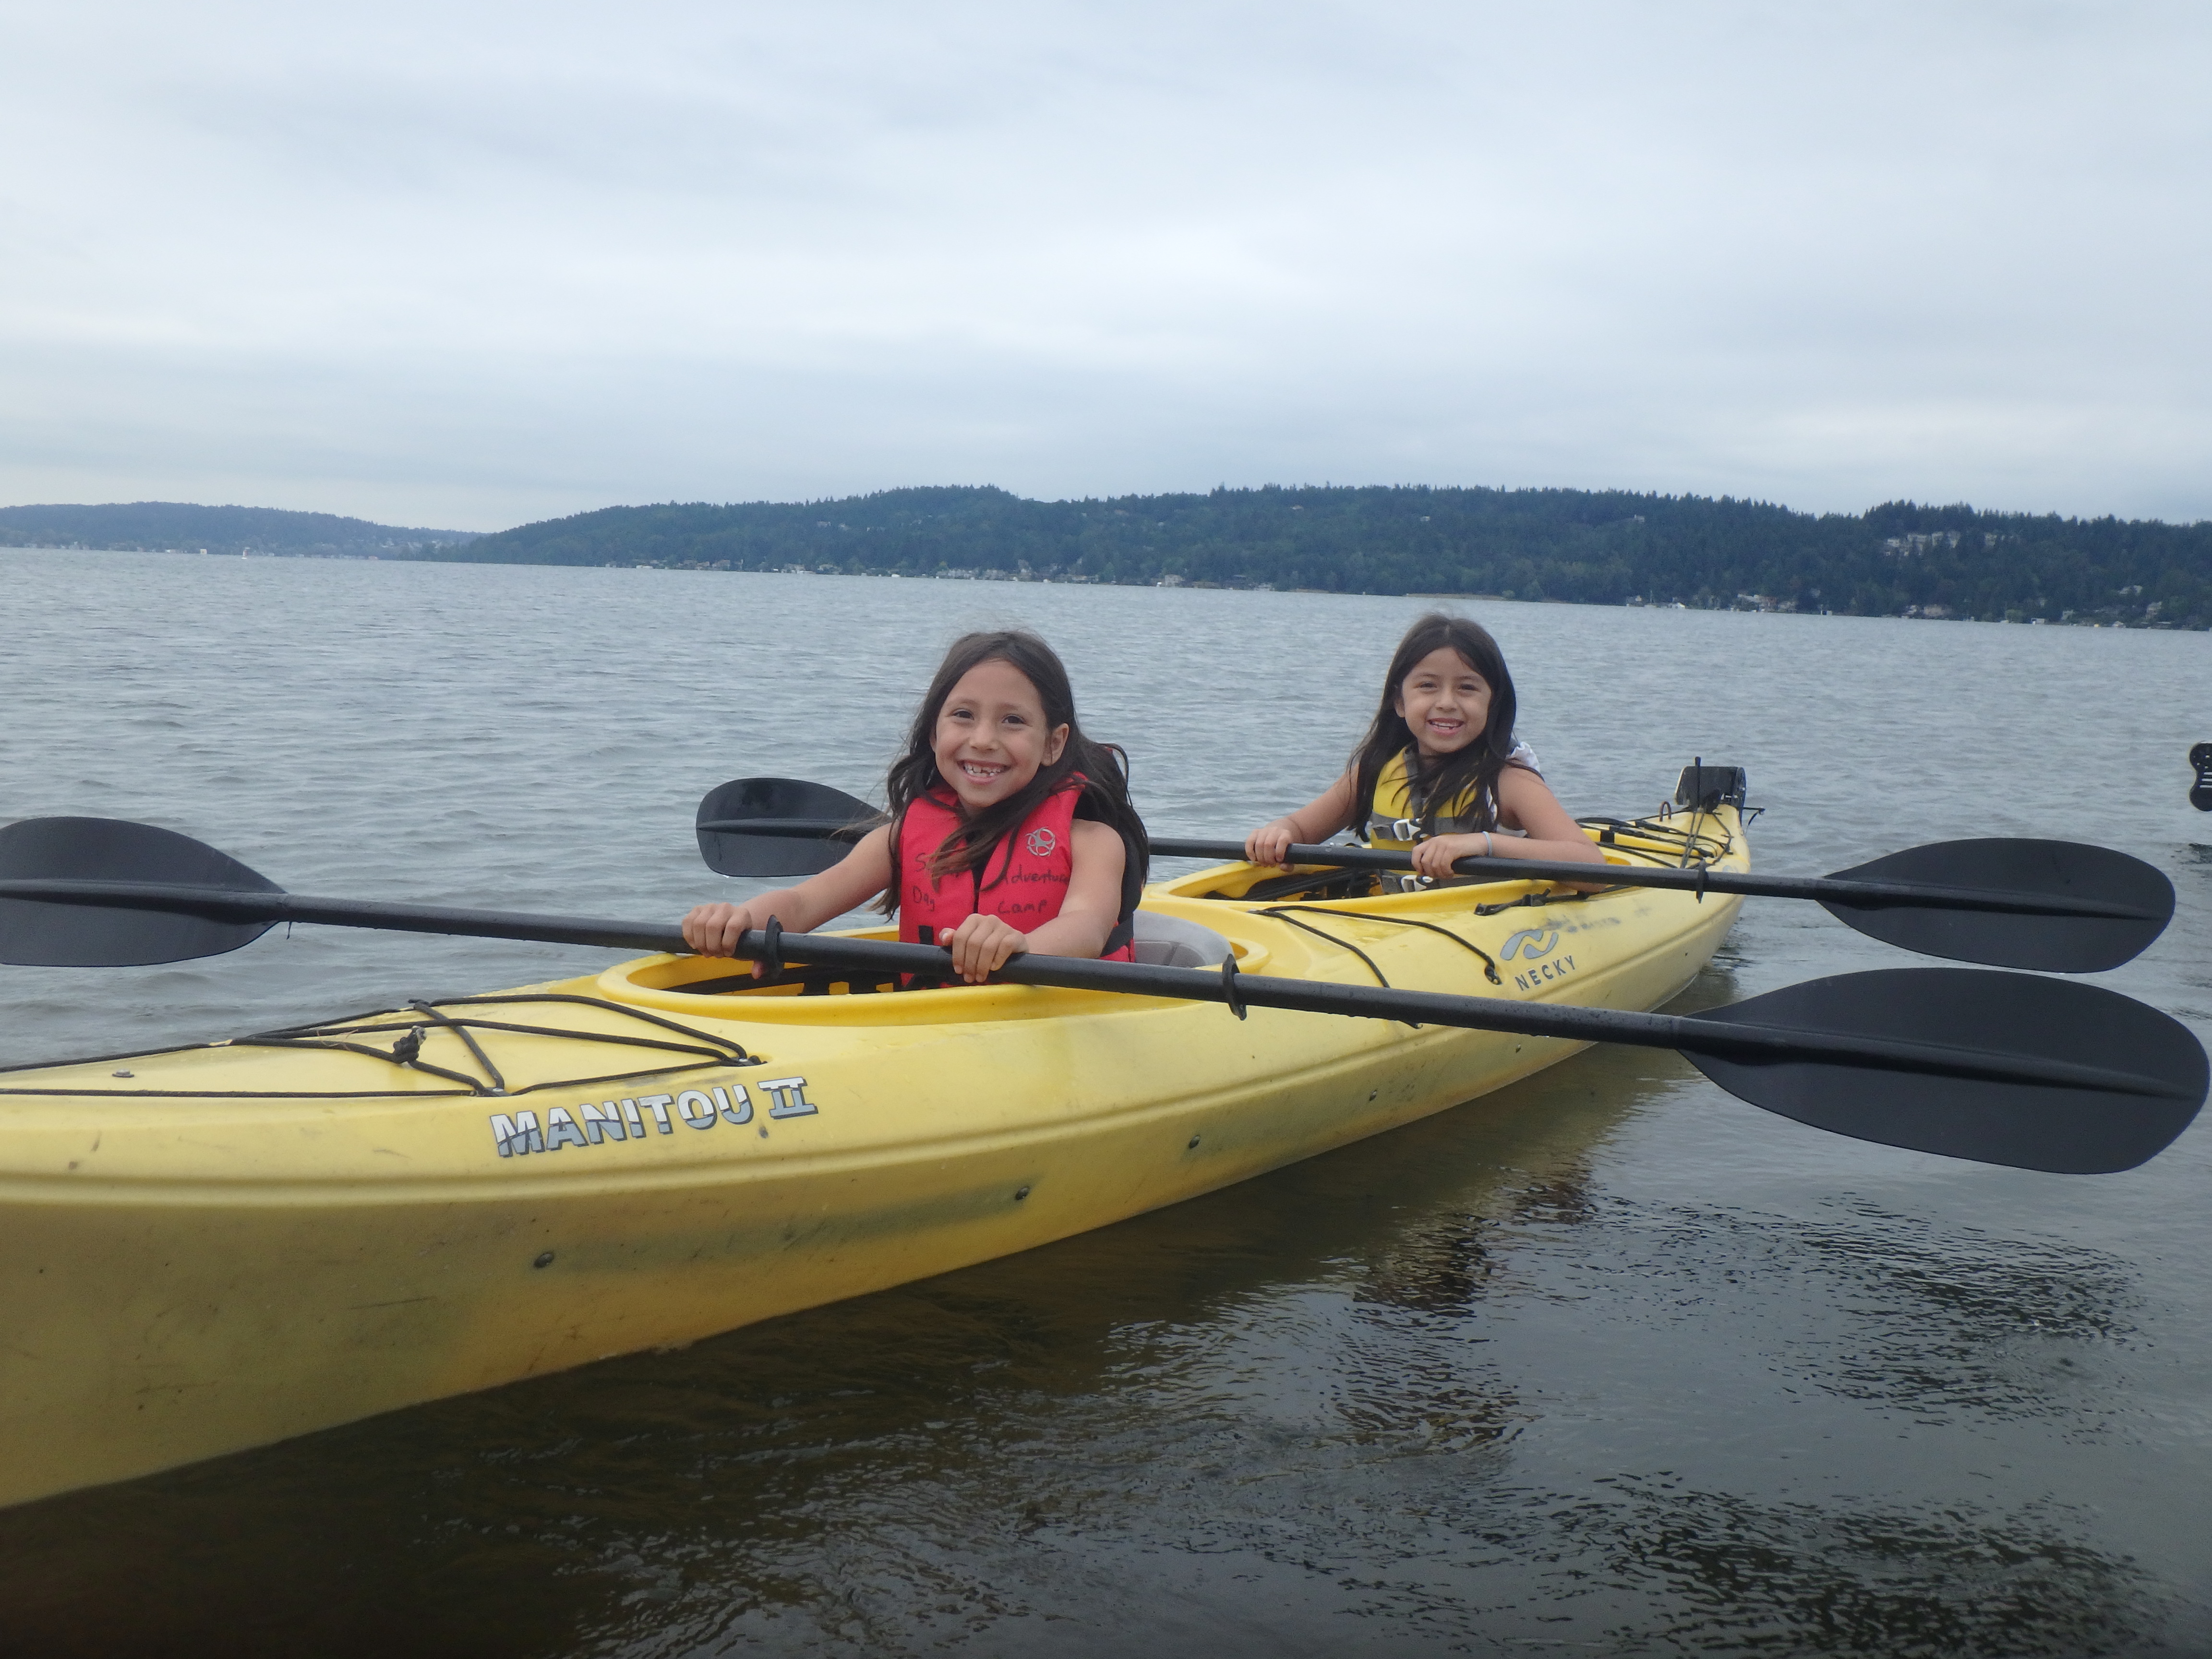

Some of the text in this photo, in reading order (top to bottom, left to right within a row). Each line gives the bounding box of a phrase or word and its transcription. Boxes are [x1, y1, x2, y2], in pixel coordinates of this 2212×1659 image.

[913, 886, 935, 912] Day
[1515, 955, 1575, 991] NECKY
[490, 1076, 819, 1158] MANITOU II
